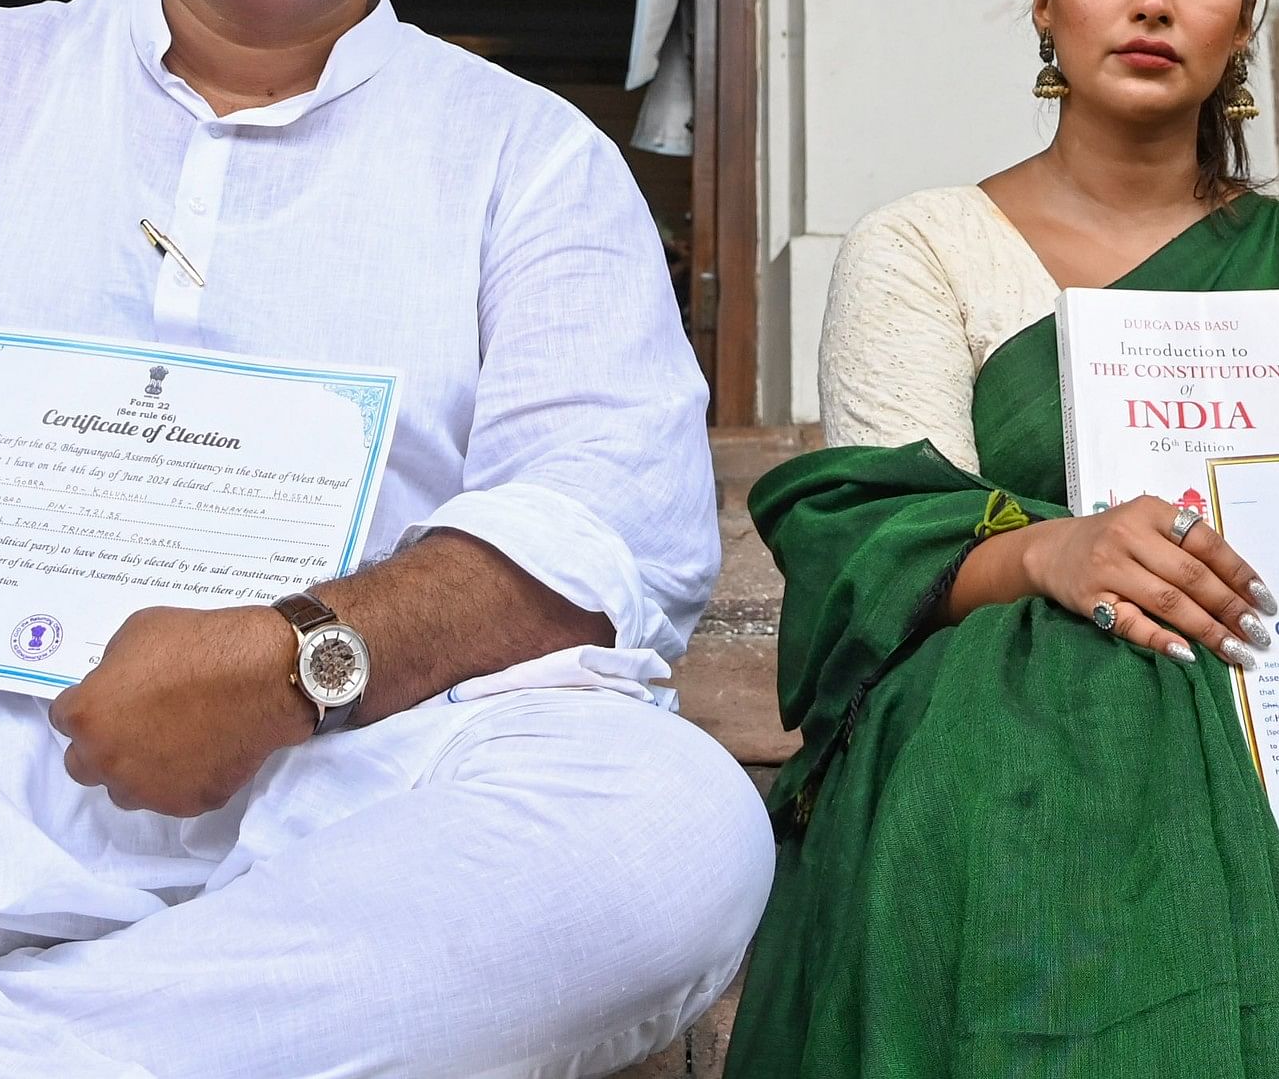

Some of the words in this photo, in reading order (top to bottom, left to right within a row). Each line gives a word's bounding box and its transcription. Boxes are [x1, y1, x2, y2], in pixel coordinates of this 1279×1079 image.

[1123, 319, 1171, 331] DURGA
[1175, 321, 1200, 331] DAS
[1205, 320, 1239, 331] BASU
[1120, 341, 1226, 358] Introduction
[1232, 344, 1248, 358] to
[1090, 362, 1129, 377] THE
[1180, 383, 1195, 397] Of
[130, 398, 154, 408] Form
[157, 402, 170, 410] 22
[117, 408, 137, 416] (See
[161, 414, 176, 423] 66)
[1124, 399, 1257, 430] INDIA
[42, 409, 139, 436] Certificate
[142, 424, 166, 443] of
[165, 426, 241, 450] Election
[1149, 437, 1180, 452] 26th
[1184, 440, 1235, 453] Edition
[11, 437, 28, 448] for
[29, 439, 43, 448] the
[45, 441, 57, 452] 62,
[60, 443, 121, 459] Bhagwangola
[120, 452, 165, 467] Assembly
[166, 459, 223, 475] constituency
[224, 465, 234, 474] in
[235, 466, 251, 476] the
[251, 469, 277, 479] State
[278, 472, 290, 483] of
[291, 473, 315, 483] West
[316, 476, 352, 489] Bengal
[5, 457, 11, 465] I
[13, 456, 35, 468] have
[37, 462, 49, 470] on
[52, 462, 67, 472] the
[70, 465, 86, 475] 4th
[88, 466, 106, 479] day
[108, 470, 120, 481] of
[120, 472, 144, 482] June
[146, 475, 170, 485] 2024
[172, 477, 212, 491] declared
